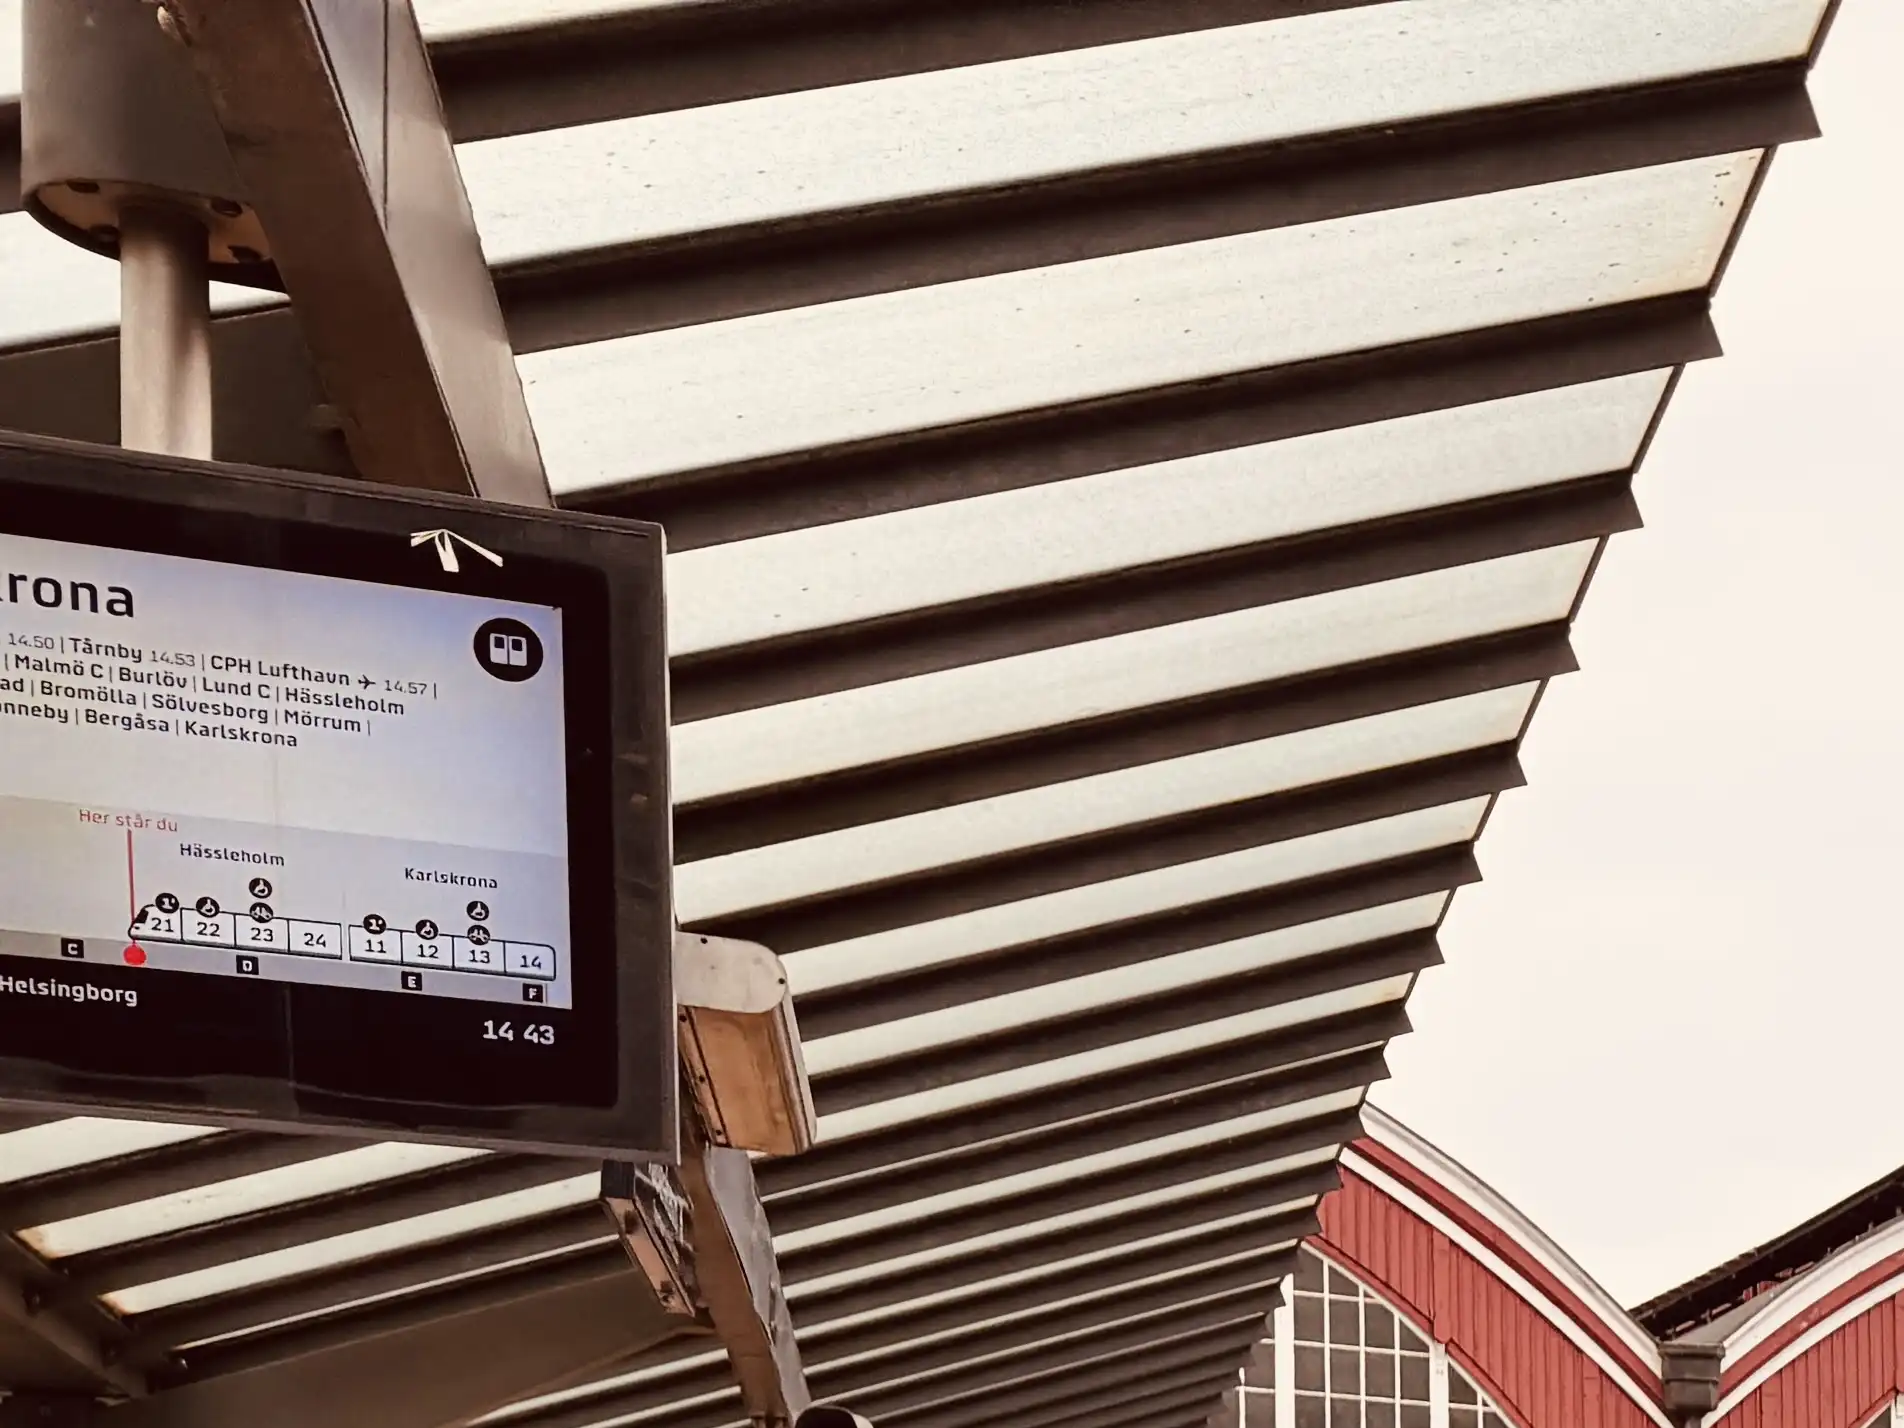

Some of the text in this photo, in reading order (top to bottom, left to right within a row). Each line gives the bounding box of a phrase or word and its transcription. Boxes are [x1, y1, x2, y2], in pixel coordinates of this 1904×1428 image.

[0, 572, 134, 618] rona
[8, 632, 428, 695] 14.50 Tårnby 14.53 CPH Lufthavn 14.57
[15, 654, 404, 716] Malmö C Burlöv Lund C Hässleholm
[41, 681, 137, 706] Bromölla
[152, 694, 269, 724] Sölvesborg
[285, 710, 361, 732] Mörrum
[0, 701, 298, 747] nneby Bergåsa Karlskrona
[79, 809, 179, 833] Her står du
[180, 843, 285, 867] Hässleholm
[404, 867, 498, 890] Karlskrona
[151, 917, 175, 934] 21
[197, 922, 220, 938] 22
[250, 928, 274, 943] 23
[304, 932, 326, 948] 24
[67, 943, 79, 955] C
[364, 939, 387, 954] 11
[417, 944, 439, 960] 12
[468, 950, 490, 965] 13
[519, 954, 542, 970] 14
[243, 960, 253, 972] D
[407, 976, 417, 988] E
[0, 975, 138, 1007] Helsingborg
[528, 988, 539, 1000] F
[482, 1020, 555, 1045] 14 43
